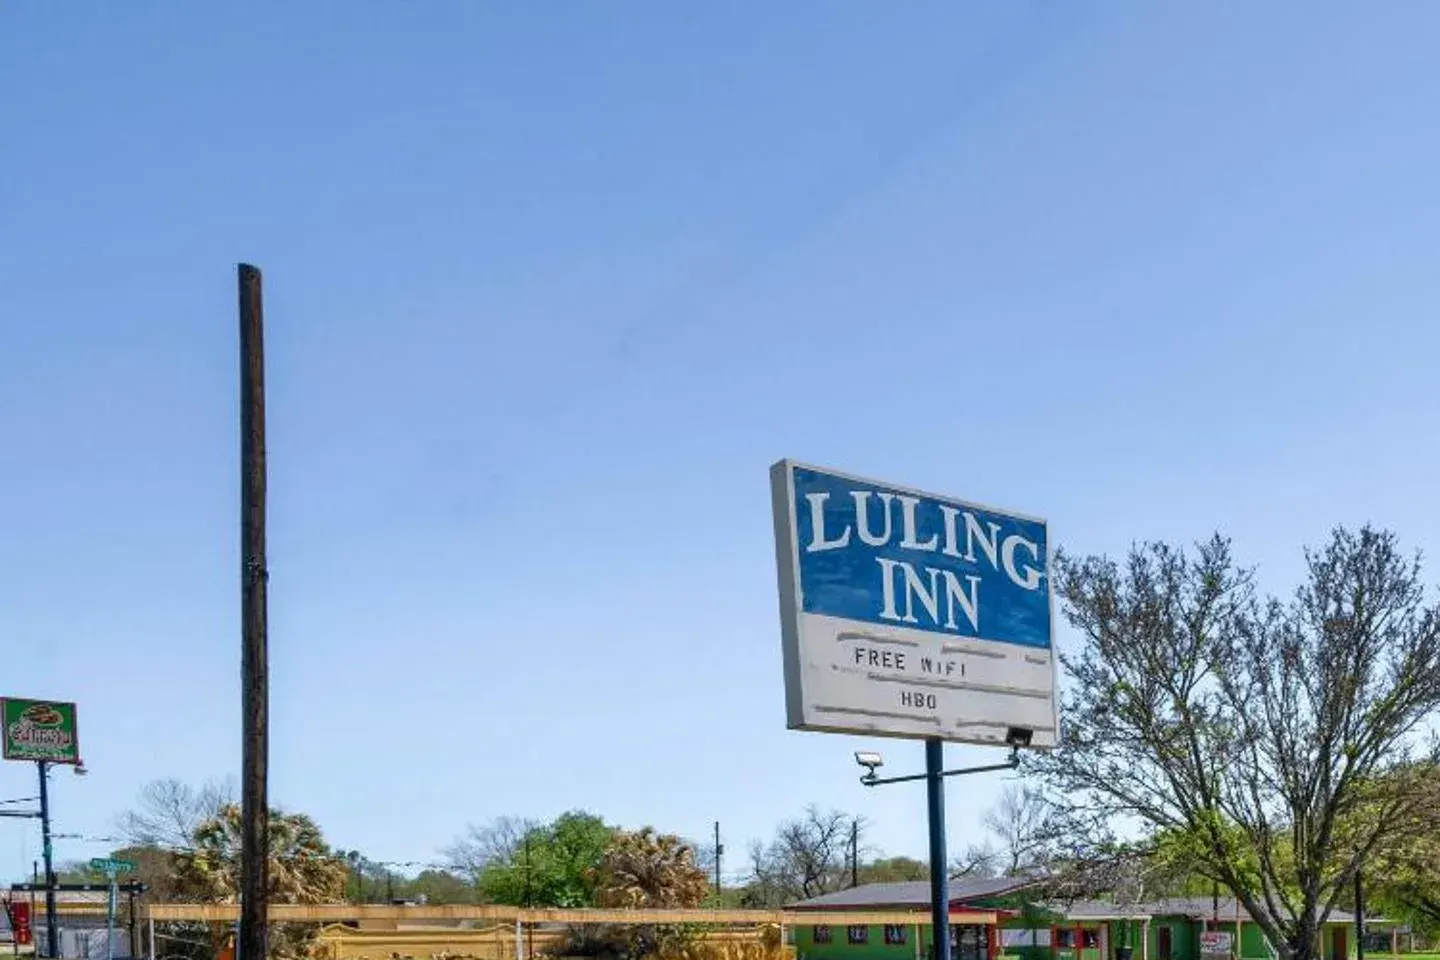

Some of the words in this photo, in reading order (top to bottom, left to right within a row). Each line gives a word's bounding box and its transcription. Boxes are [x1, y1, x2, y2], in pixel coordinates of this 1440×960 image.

[805, 491, 1046, 590] LULING
[875, 557, 981, 632] INN
[855, 648, 906, 671] FREE
[901, 691, 937, 710] HBO
